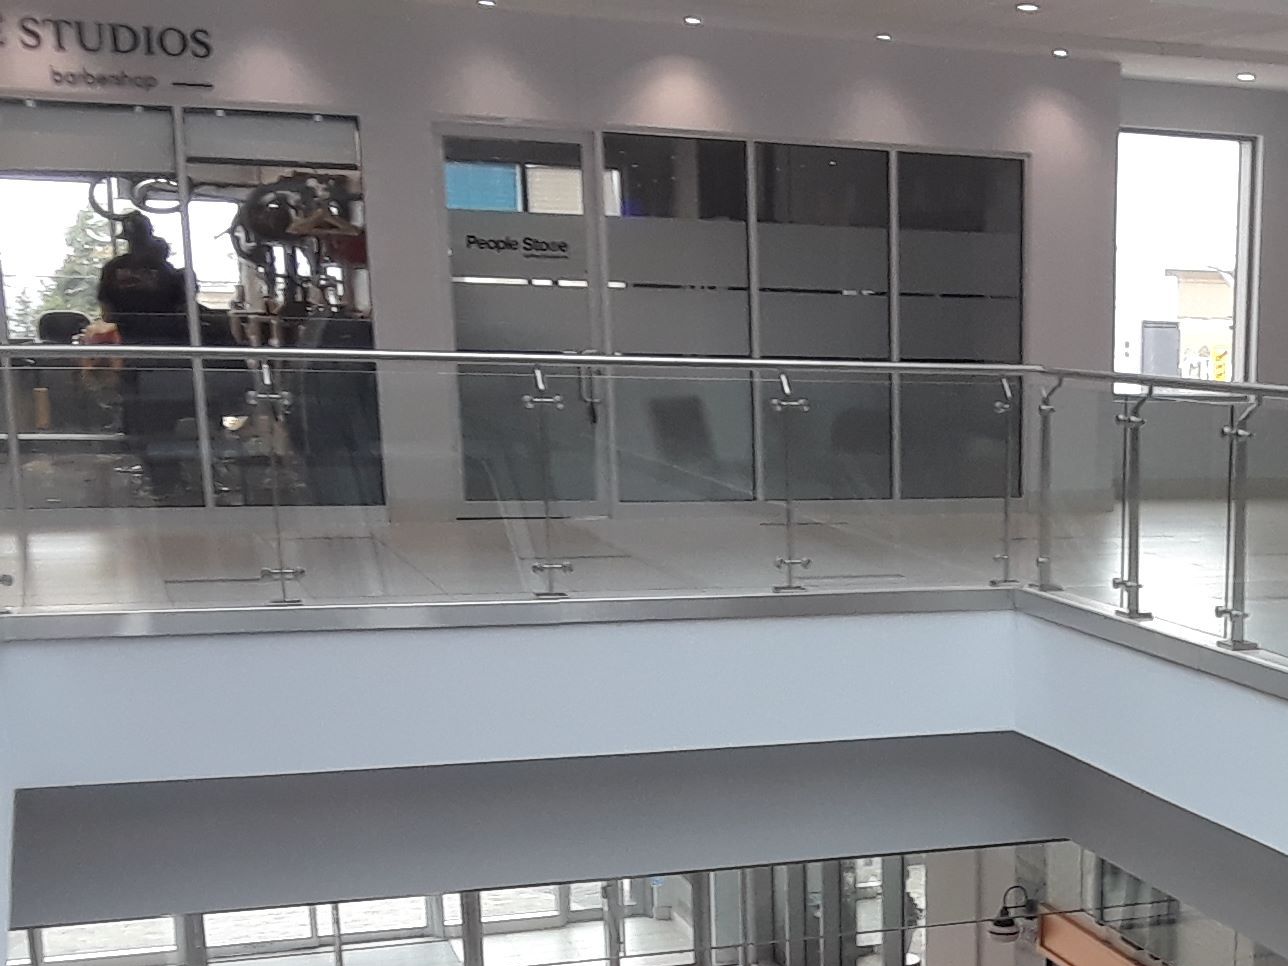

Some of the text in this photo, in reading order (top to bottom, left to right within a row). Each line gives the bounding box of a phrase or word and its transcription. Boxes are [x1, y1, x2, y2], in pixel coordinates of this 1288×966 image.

[19, 16, 211, 58] STUDIOS
[50, 65, 157, 91] barbershop
[466, 234, 519, 253] People
